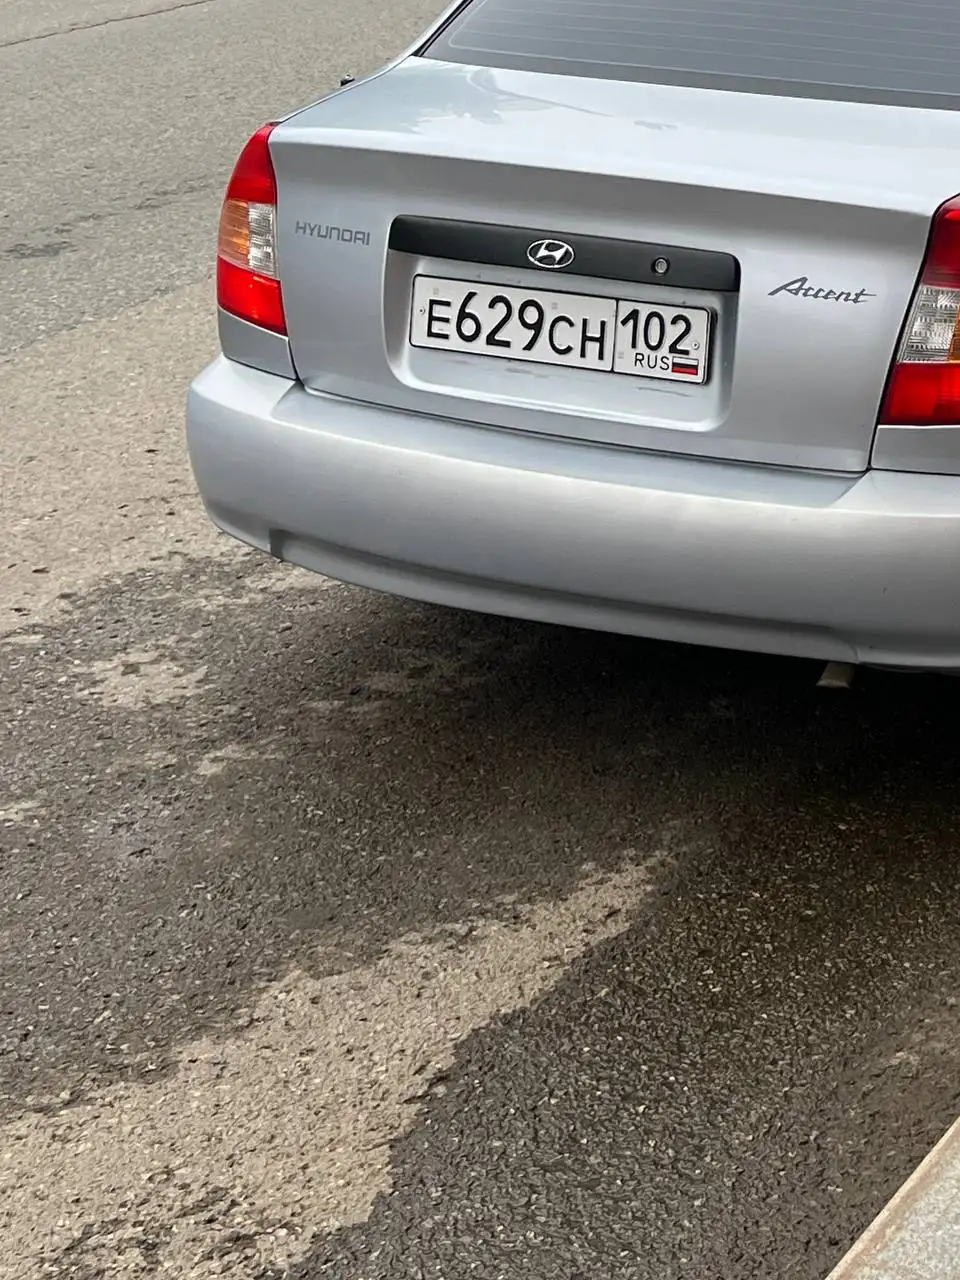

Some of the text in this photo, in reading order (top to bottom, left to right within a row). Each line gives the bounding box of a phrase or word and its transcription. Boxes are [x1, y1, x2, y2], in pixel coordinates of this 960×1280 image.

[295, 220, 370, 246] HYUNDAI
[768, 276, 877, 304] Accent
[620, 308, 692, 356] 102
[634, 352, 670, 371] RUS
